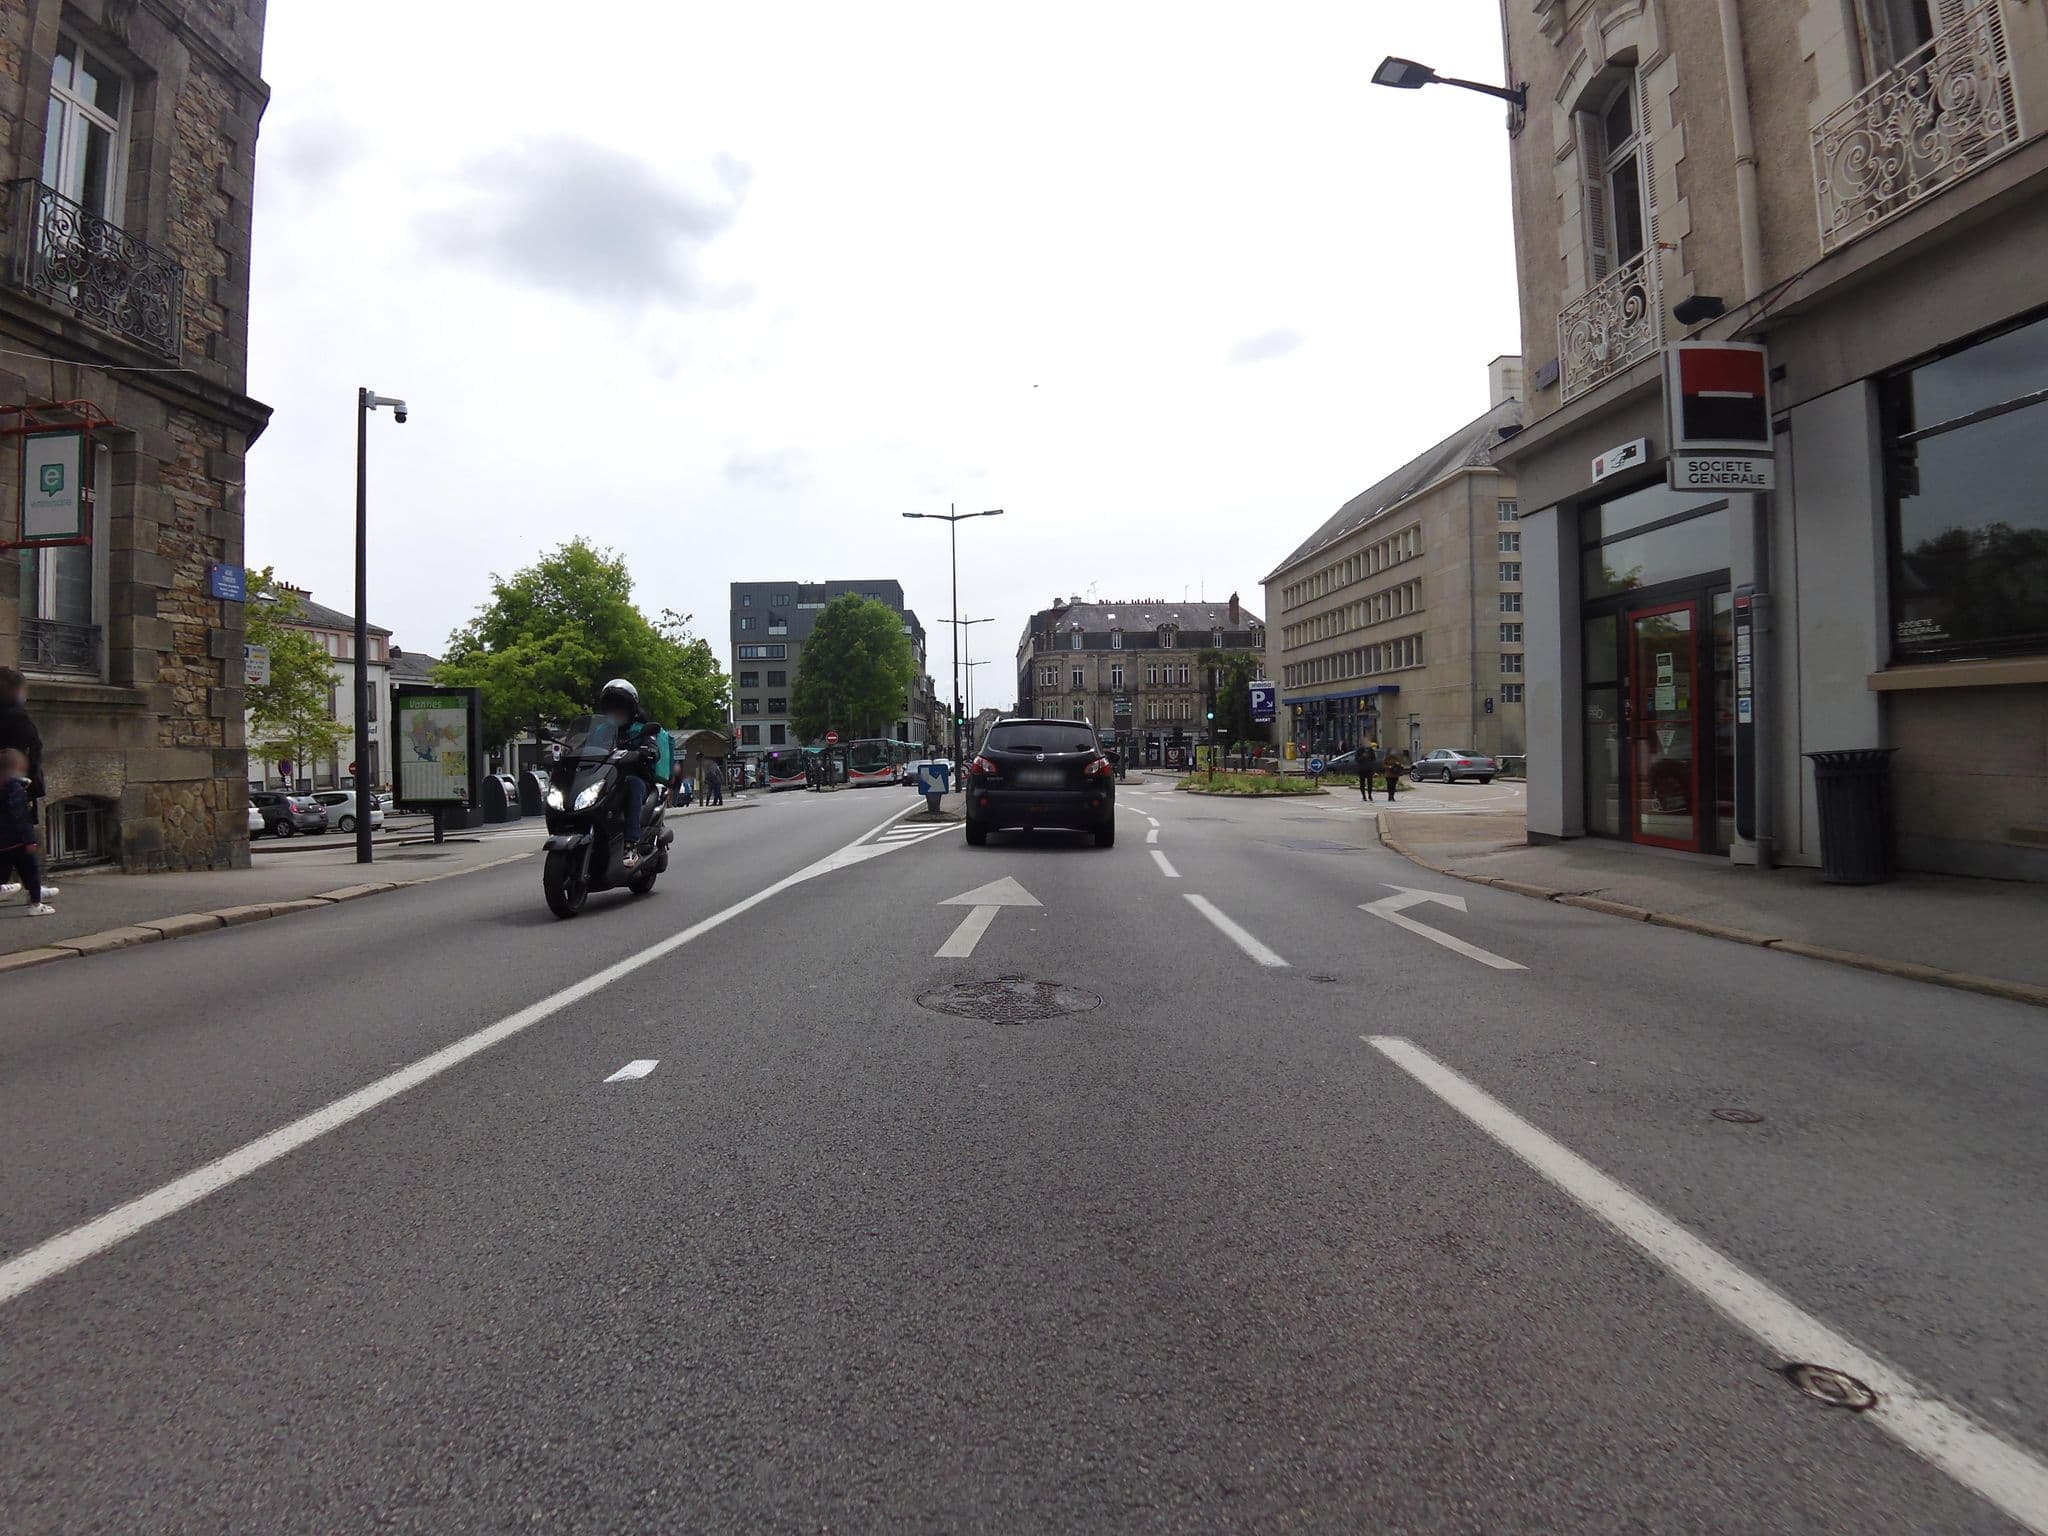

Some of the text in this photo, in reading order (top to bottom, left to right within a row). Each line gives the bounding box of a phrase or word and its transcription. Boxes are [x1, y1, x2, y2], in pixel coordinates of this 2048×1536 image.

[1688, 461, 1752, 472] SOCIETE
[1688, 473, 1766, 485] GENERALE
[1897, 618, 1933, 629] SOCIETE
[1897, 625, 1942, 636] GENERALE
[409, 699, 442, 709] Vannes
[1252, 691, 1265, 708] P
